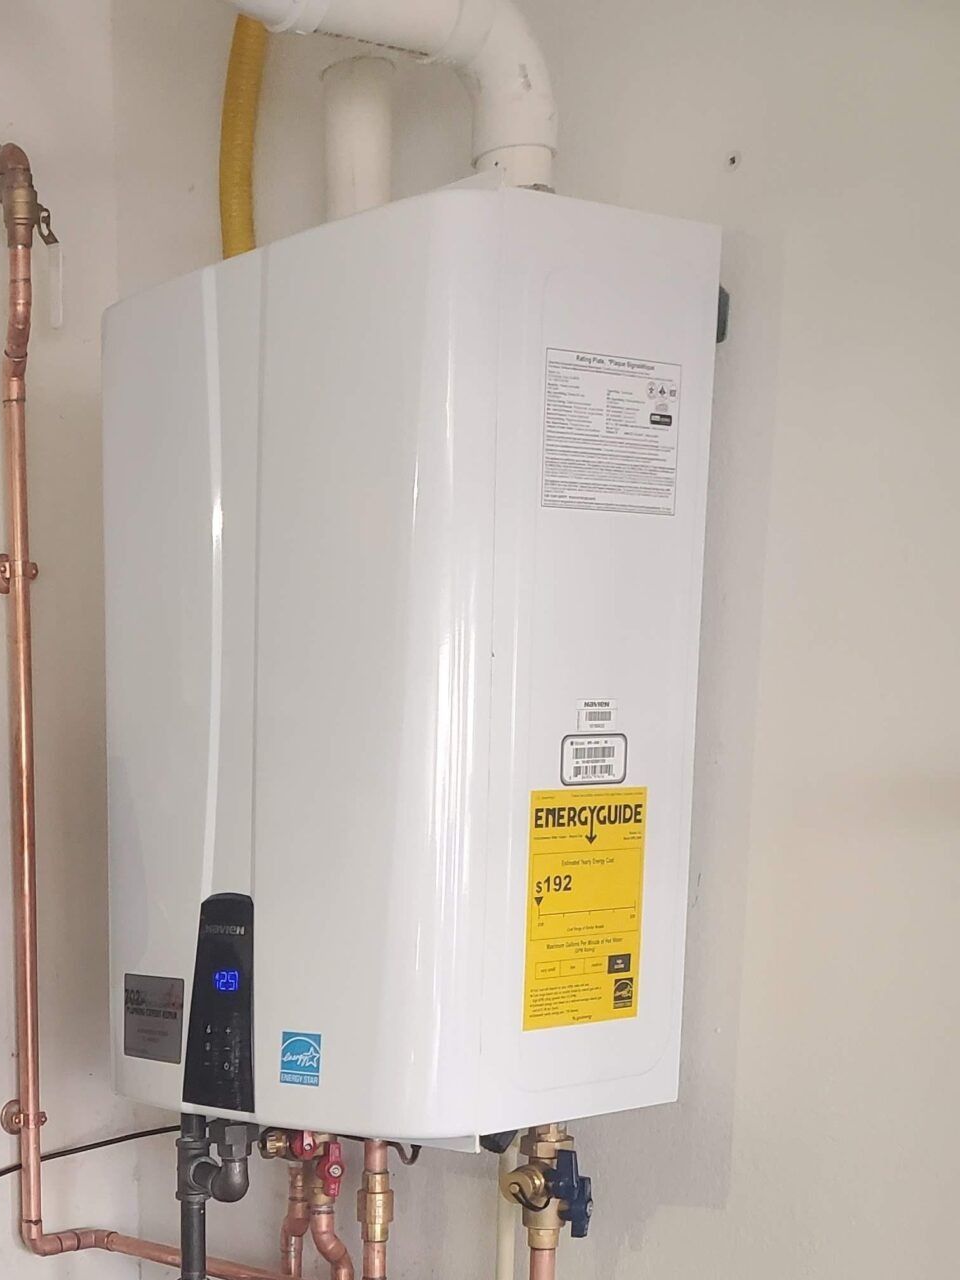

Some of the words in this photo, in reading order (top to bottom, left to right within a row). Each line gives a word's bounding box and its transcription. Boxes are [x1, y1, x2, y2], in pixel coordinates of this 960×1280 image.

[534, 804, 643, 829] ENERGYGUIDE
[535, 875, 572, 893] $192
[303, 1075, 319, 1085] STAR
